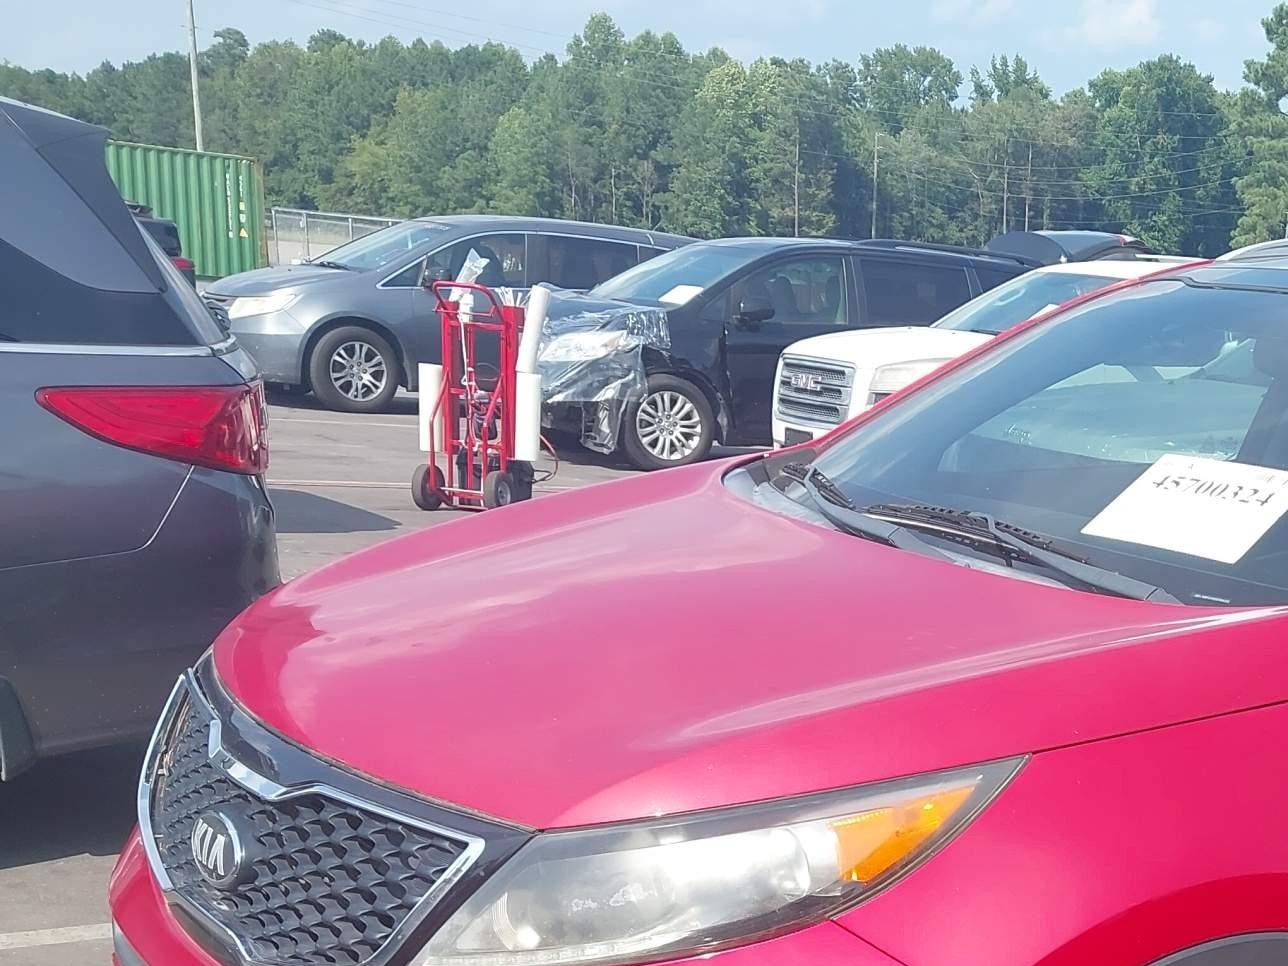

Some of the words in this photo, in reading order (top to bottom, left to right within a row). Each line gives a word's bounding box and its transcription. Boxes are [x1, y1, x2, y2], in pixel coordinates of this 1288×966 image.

[791, 374, 822, 391] GMC
[1152, 475, 1276, 507] 45700324
[194, 818, 225, 876] KIA
